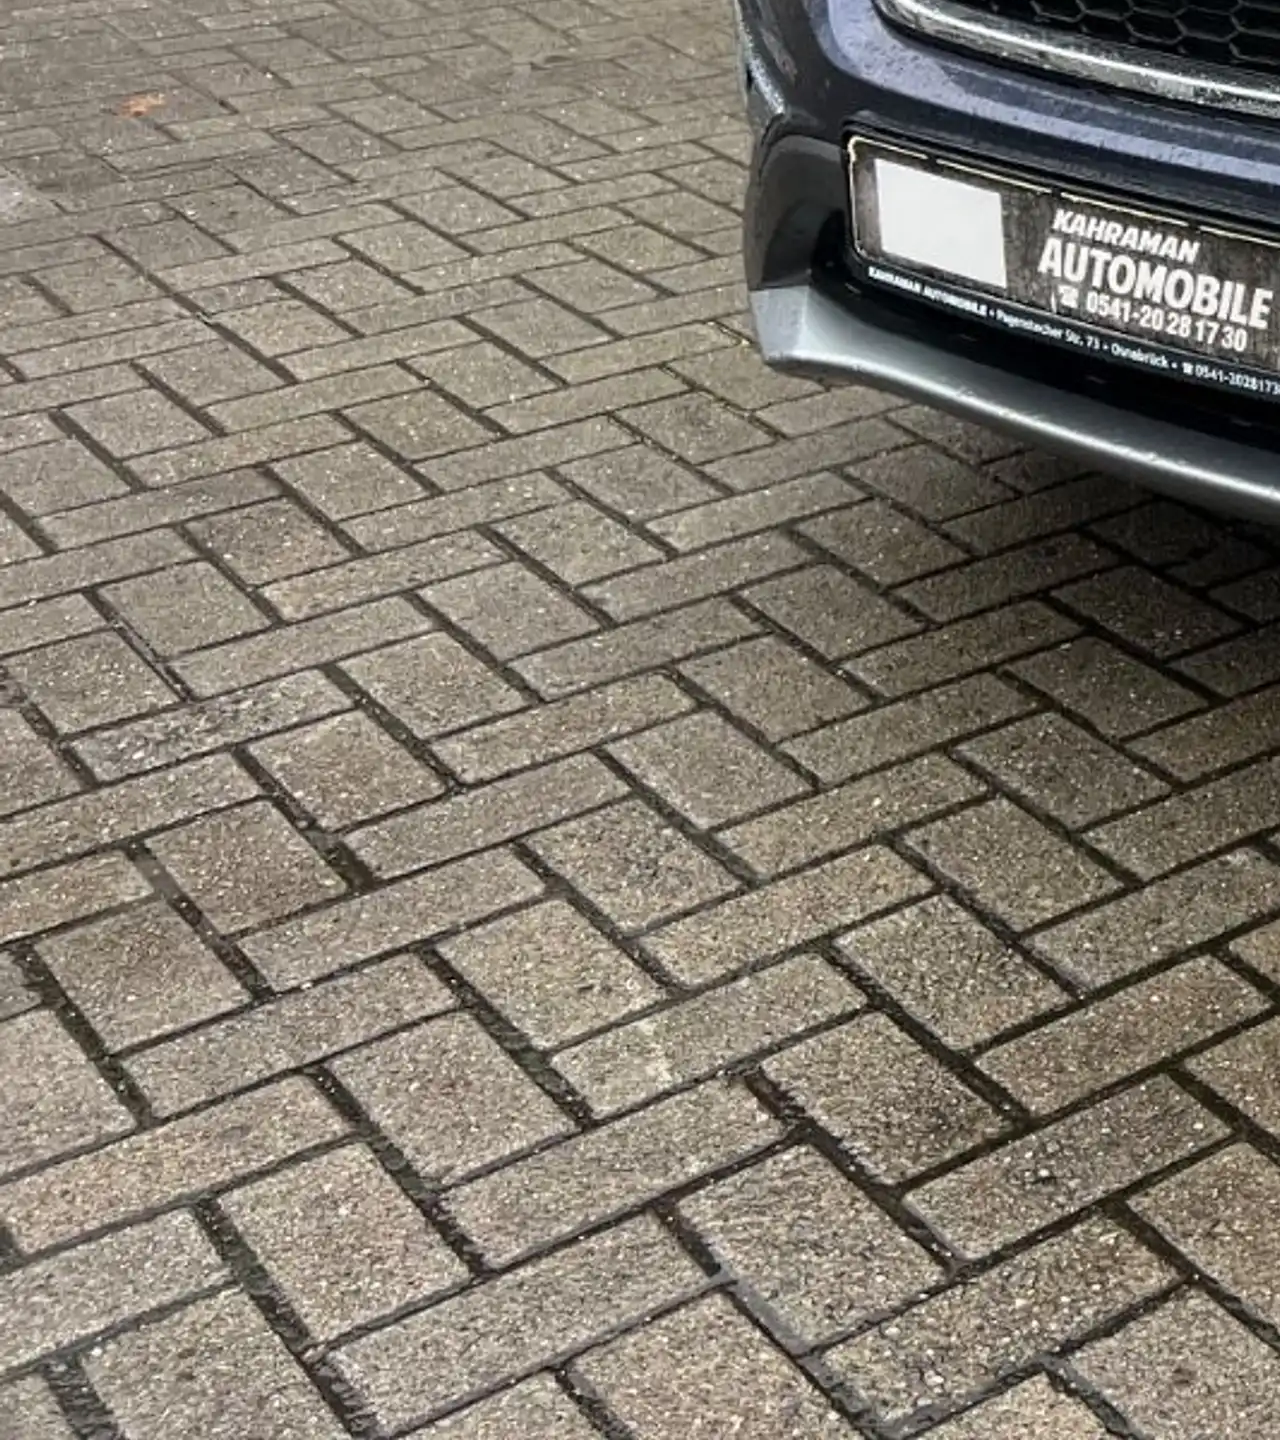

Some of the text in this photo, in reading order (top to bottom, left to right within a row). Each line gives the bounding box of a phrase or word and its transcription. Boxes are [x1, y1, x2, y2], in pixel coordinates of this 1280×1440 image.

[1052, 208, 1200, 264] KAHRAMAN
[1037, 237, 1273, 329] AUTOMOBILE
[1086, 291, 1248, 352] 0541-20 28 17 30
[1111, 342, 1169, 369] Osnabrück
